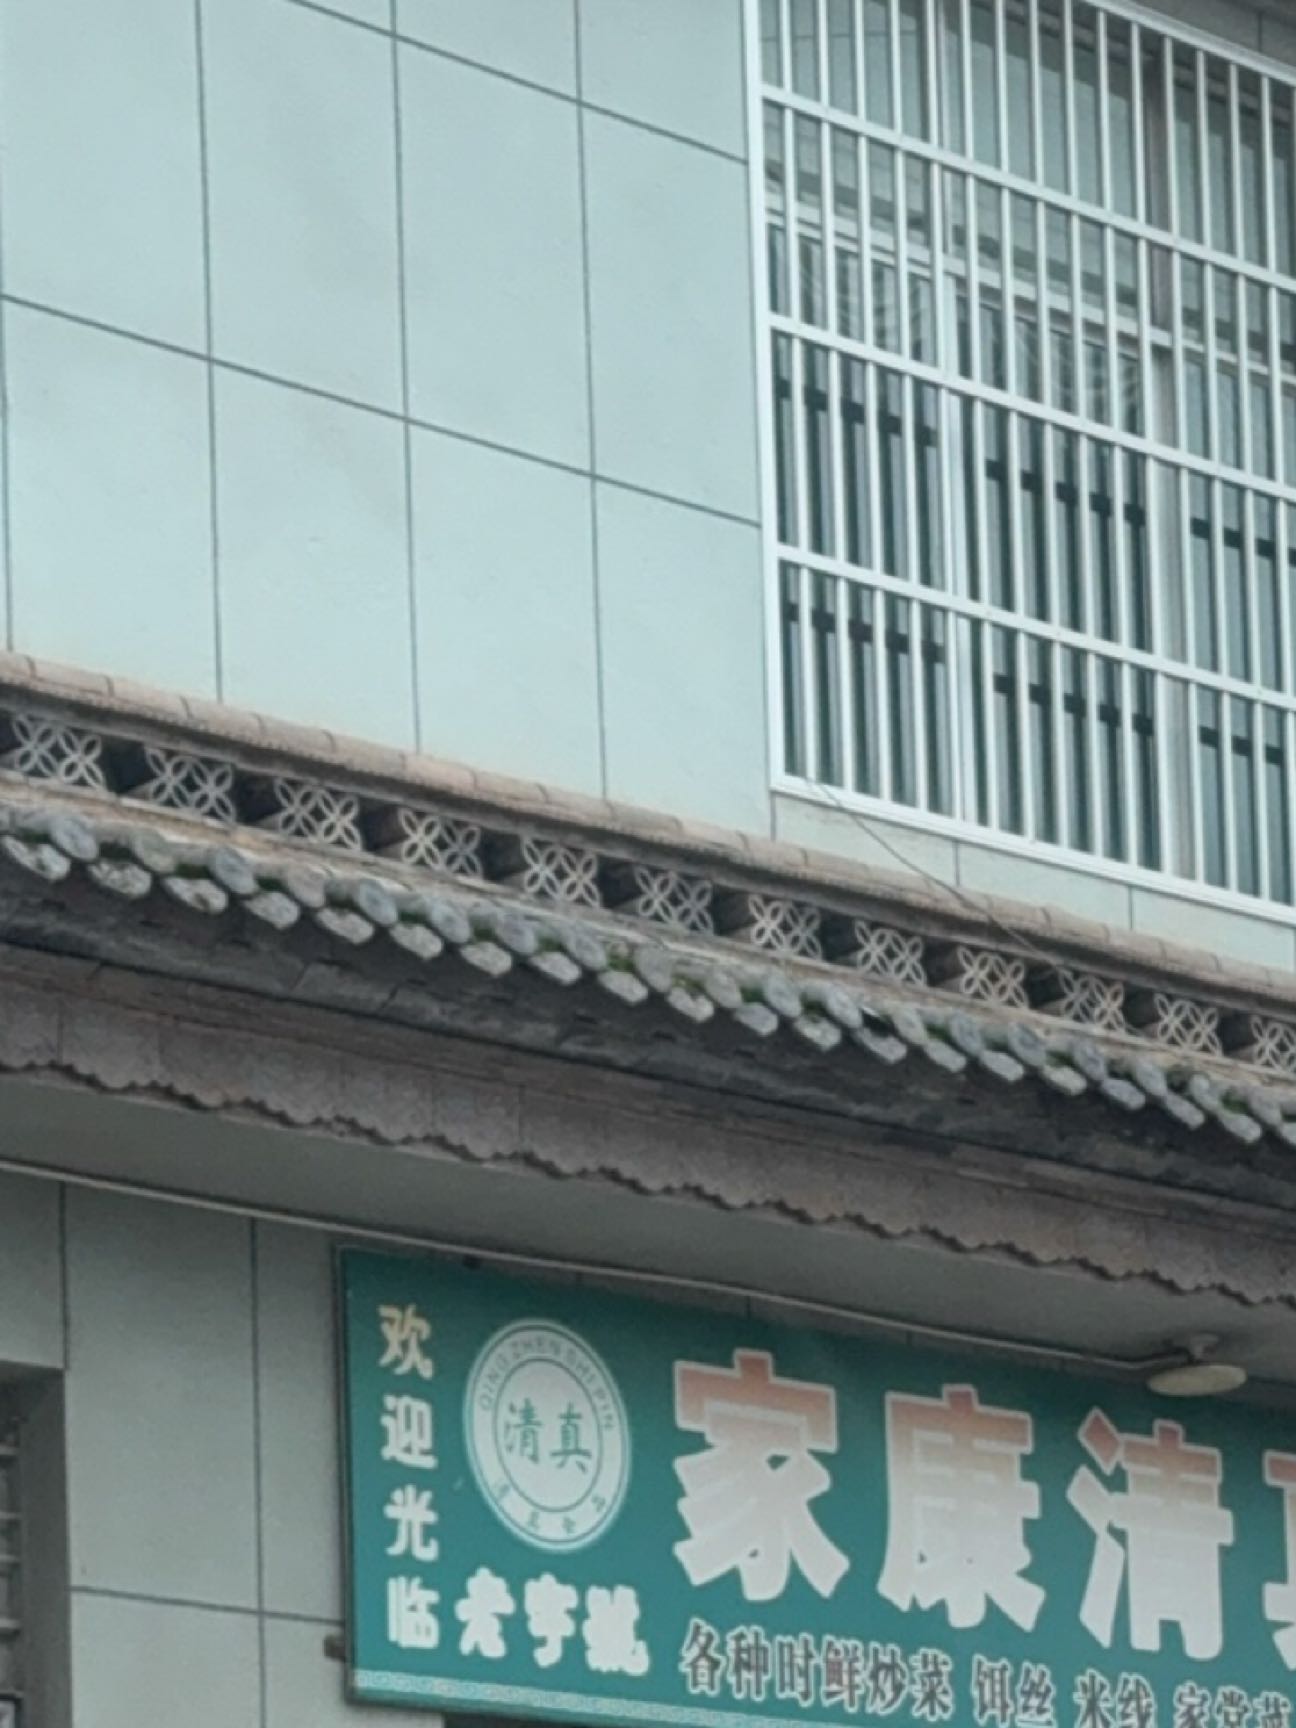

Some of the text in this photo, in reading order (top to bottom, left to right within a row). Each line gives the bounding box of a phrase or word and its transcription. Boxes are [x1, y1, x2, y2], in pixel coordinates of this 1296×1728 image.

[378, 1303, 440, 1650] 欢迎光临
[503, 1397, 592, 1475] 清真
[679, 1616, 955, 1722] 各种时鲜炒菜
